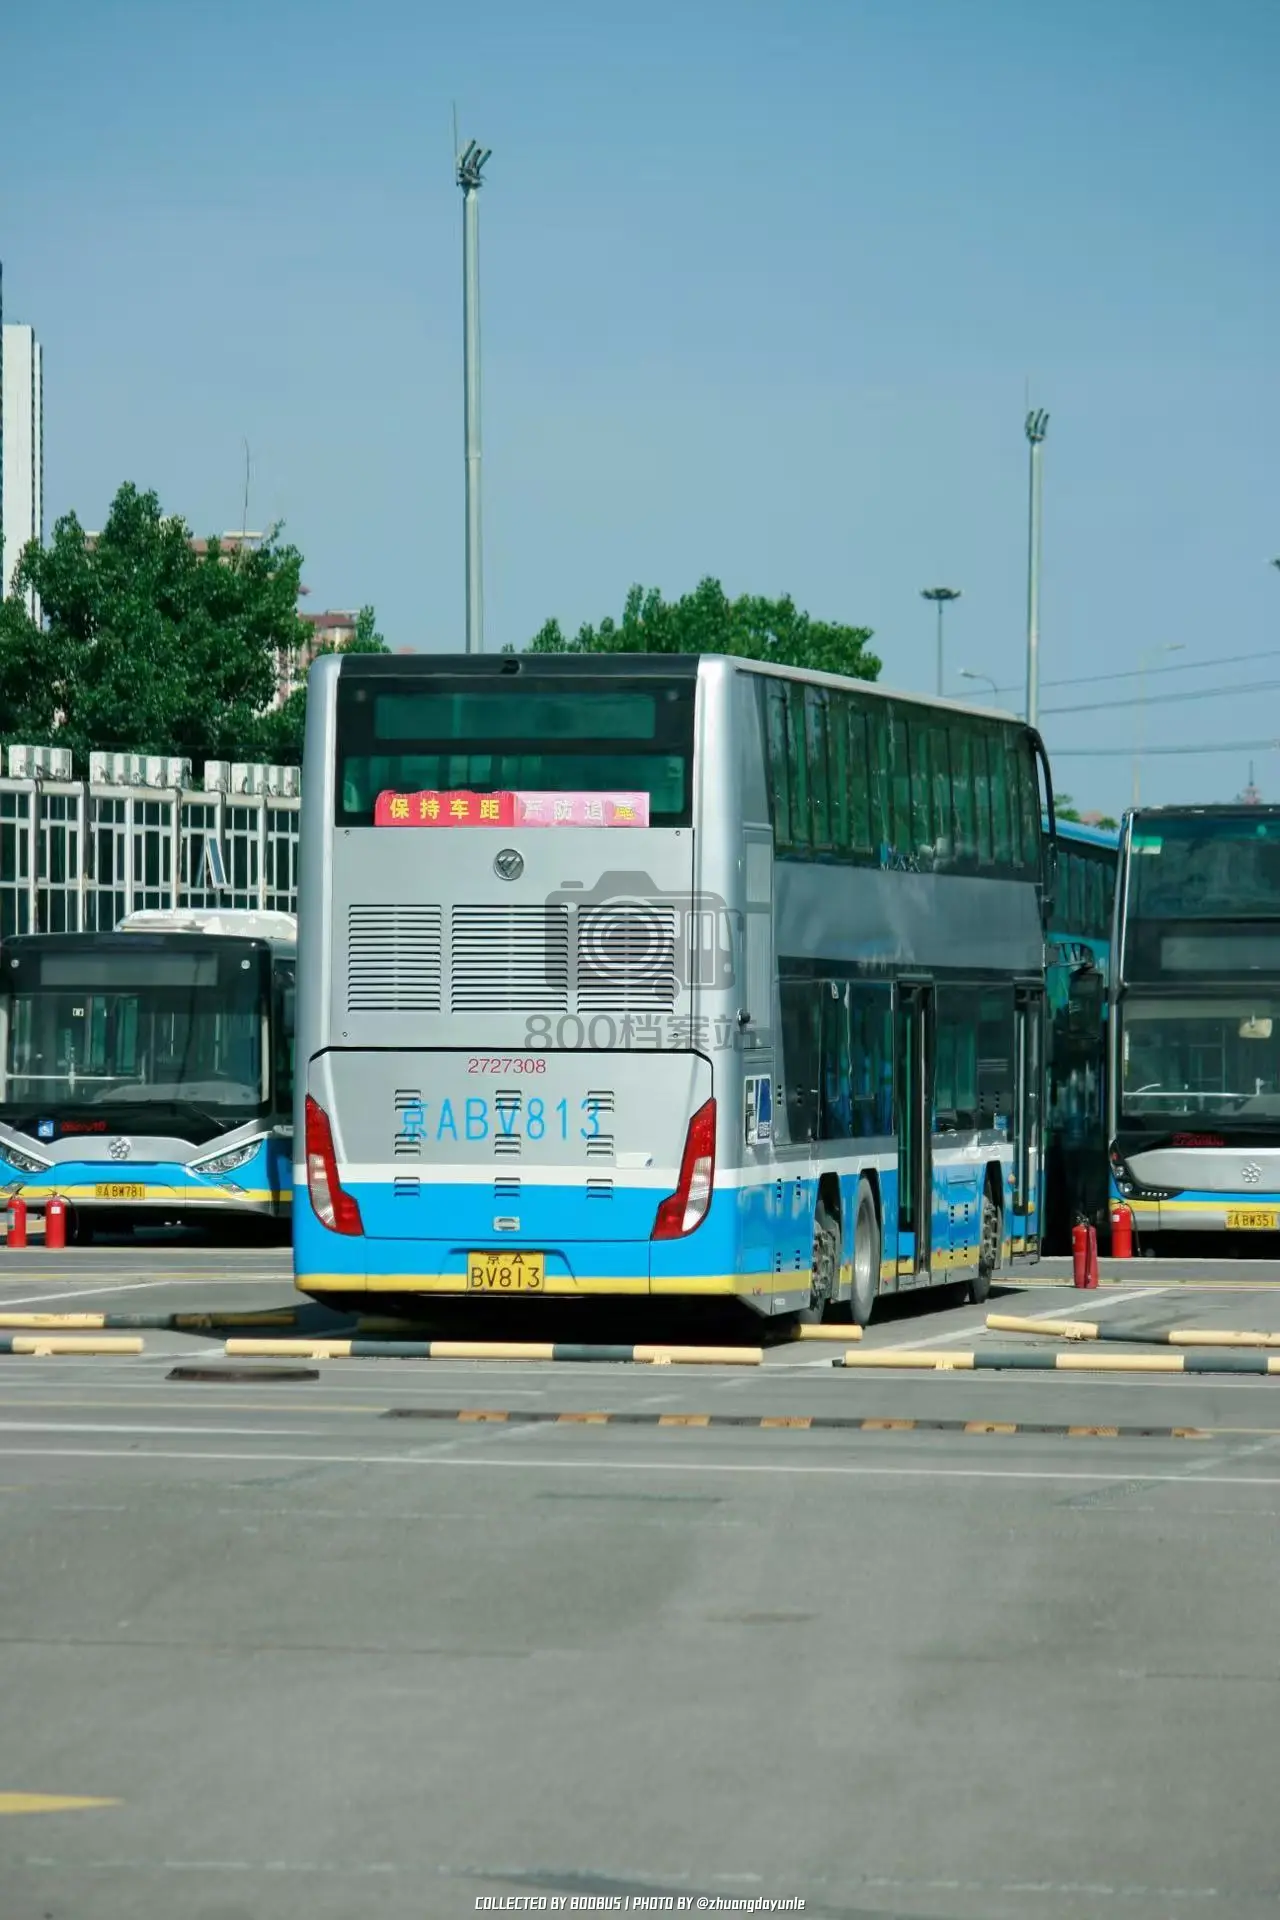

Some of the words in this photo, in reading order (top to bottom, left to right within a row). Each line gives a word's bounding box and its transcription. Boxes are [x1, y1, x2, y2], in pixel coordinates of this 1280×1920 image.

[390, 797, 500, 820] 保持车距
[468, 1058, 547, 1074] 2727308
[471, 1267, 540, 1288] BV813
